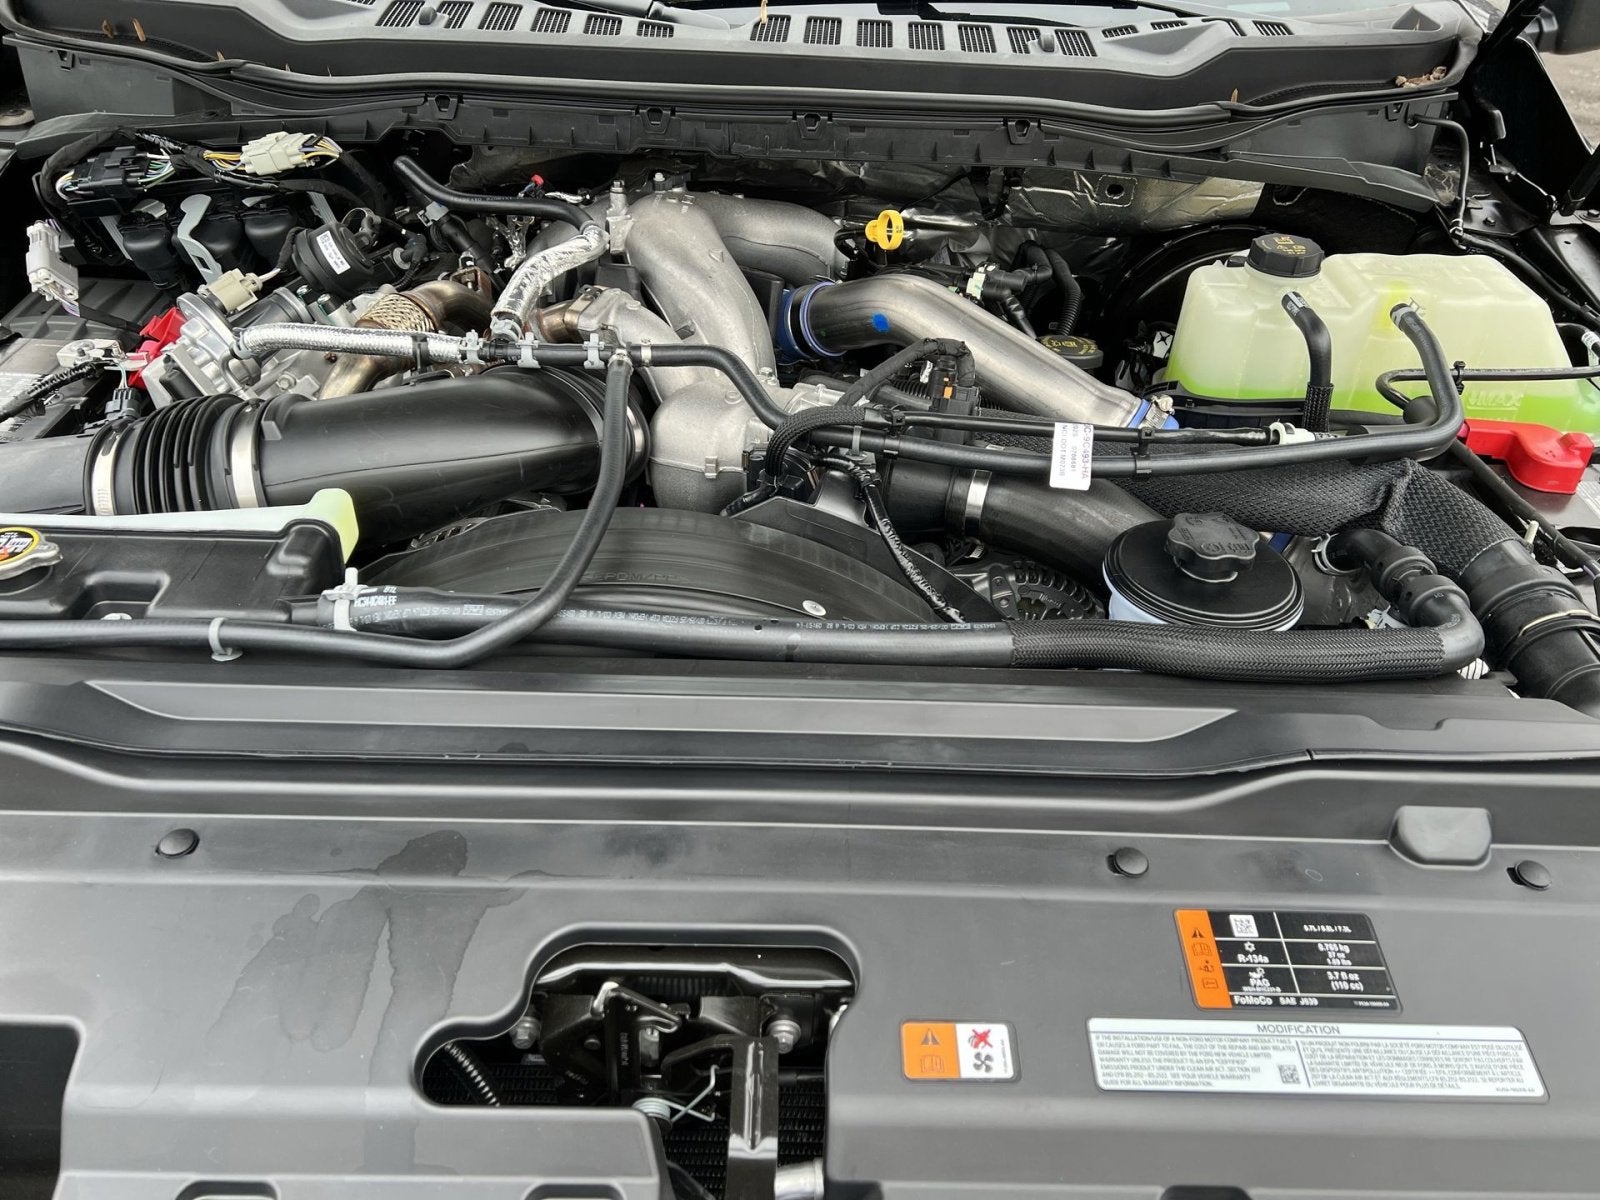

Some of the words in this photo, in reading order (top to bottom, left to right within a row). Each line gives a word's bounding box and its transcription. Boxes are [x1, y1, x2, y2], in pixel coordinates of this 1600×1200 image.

[1237, 953, 1269, 963] R-134a
[1348, 973, 1360, 981] oz
[1249, 978, 1270, 987] PAG
[1233, 995, 1273, 1005] FoMoCo
[1279, 997, 1297, 1006] SAE
[1300, 997, 1319, 1006] J639
[1256, 1023, 1341, 1034] MODIFICATION
